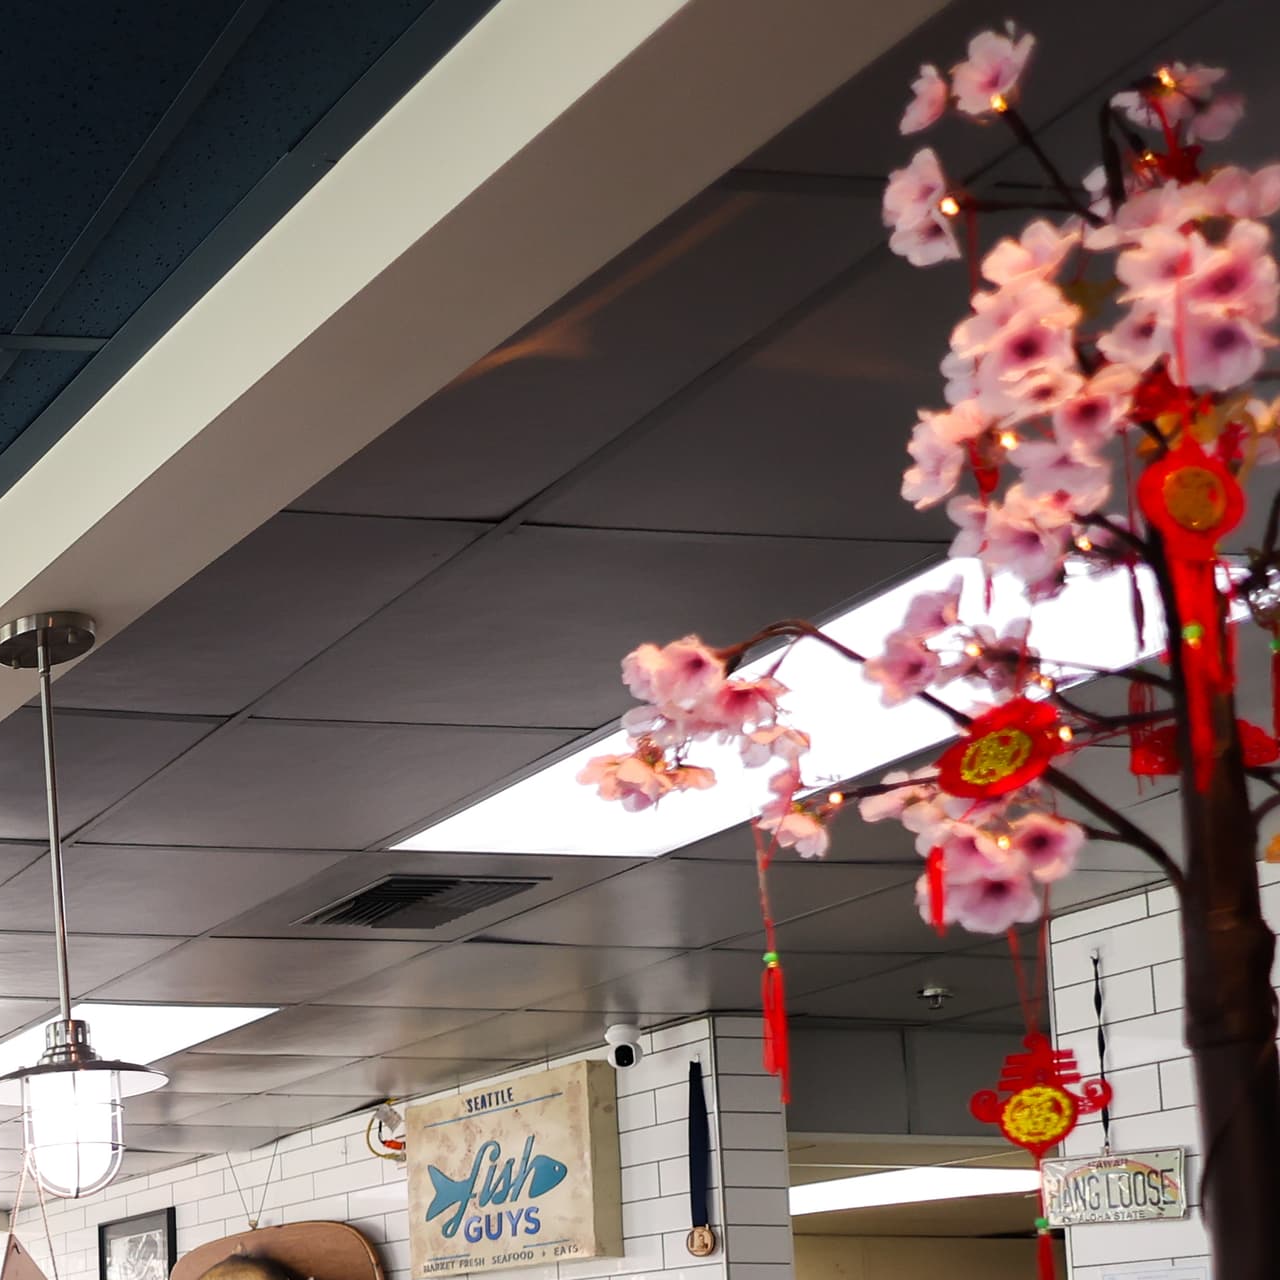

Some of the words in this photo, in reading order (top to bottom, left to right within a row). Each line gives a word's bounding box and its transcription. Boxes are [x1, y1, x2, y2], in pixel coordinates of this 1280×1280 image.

[466, 1087, 514, 1114] SEATTLE
[430, 1134, 562, 1239] fish
[1105, 1167, 1178, 1210] LOOSE
[464, 1206, 541, 1244] GUYS
[1114, 1210, 1148, 1220] STATE
[423, 1260, 456, 1274] MARKET
[458, 1257, 486, 1269] FRESH
[491, 1250, 534, 1266] SEAFOOD
[553, 1244, 580, 1257] EATS
